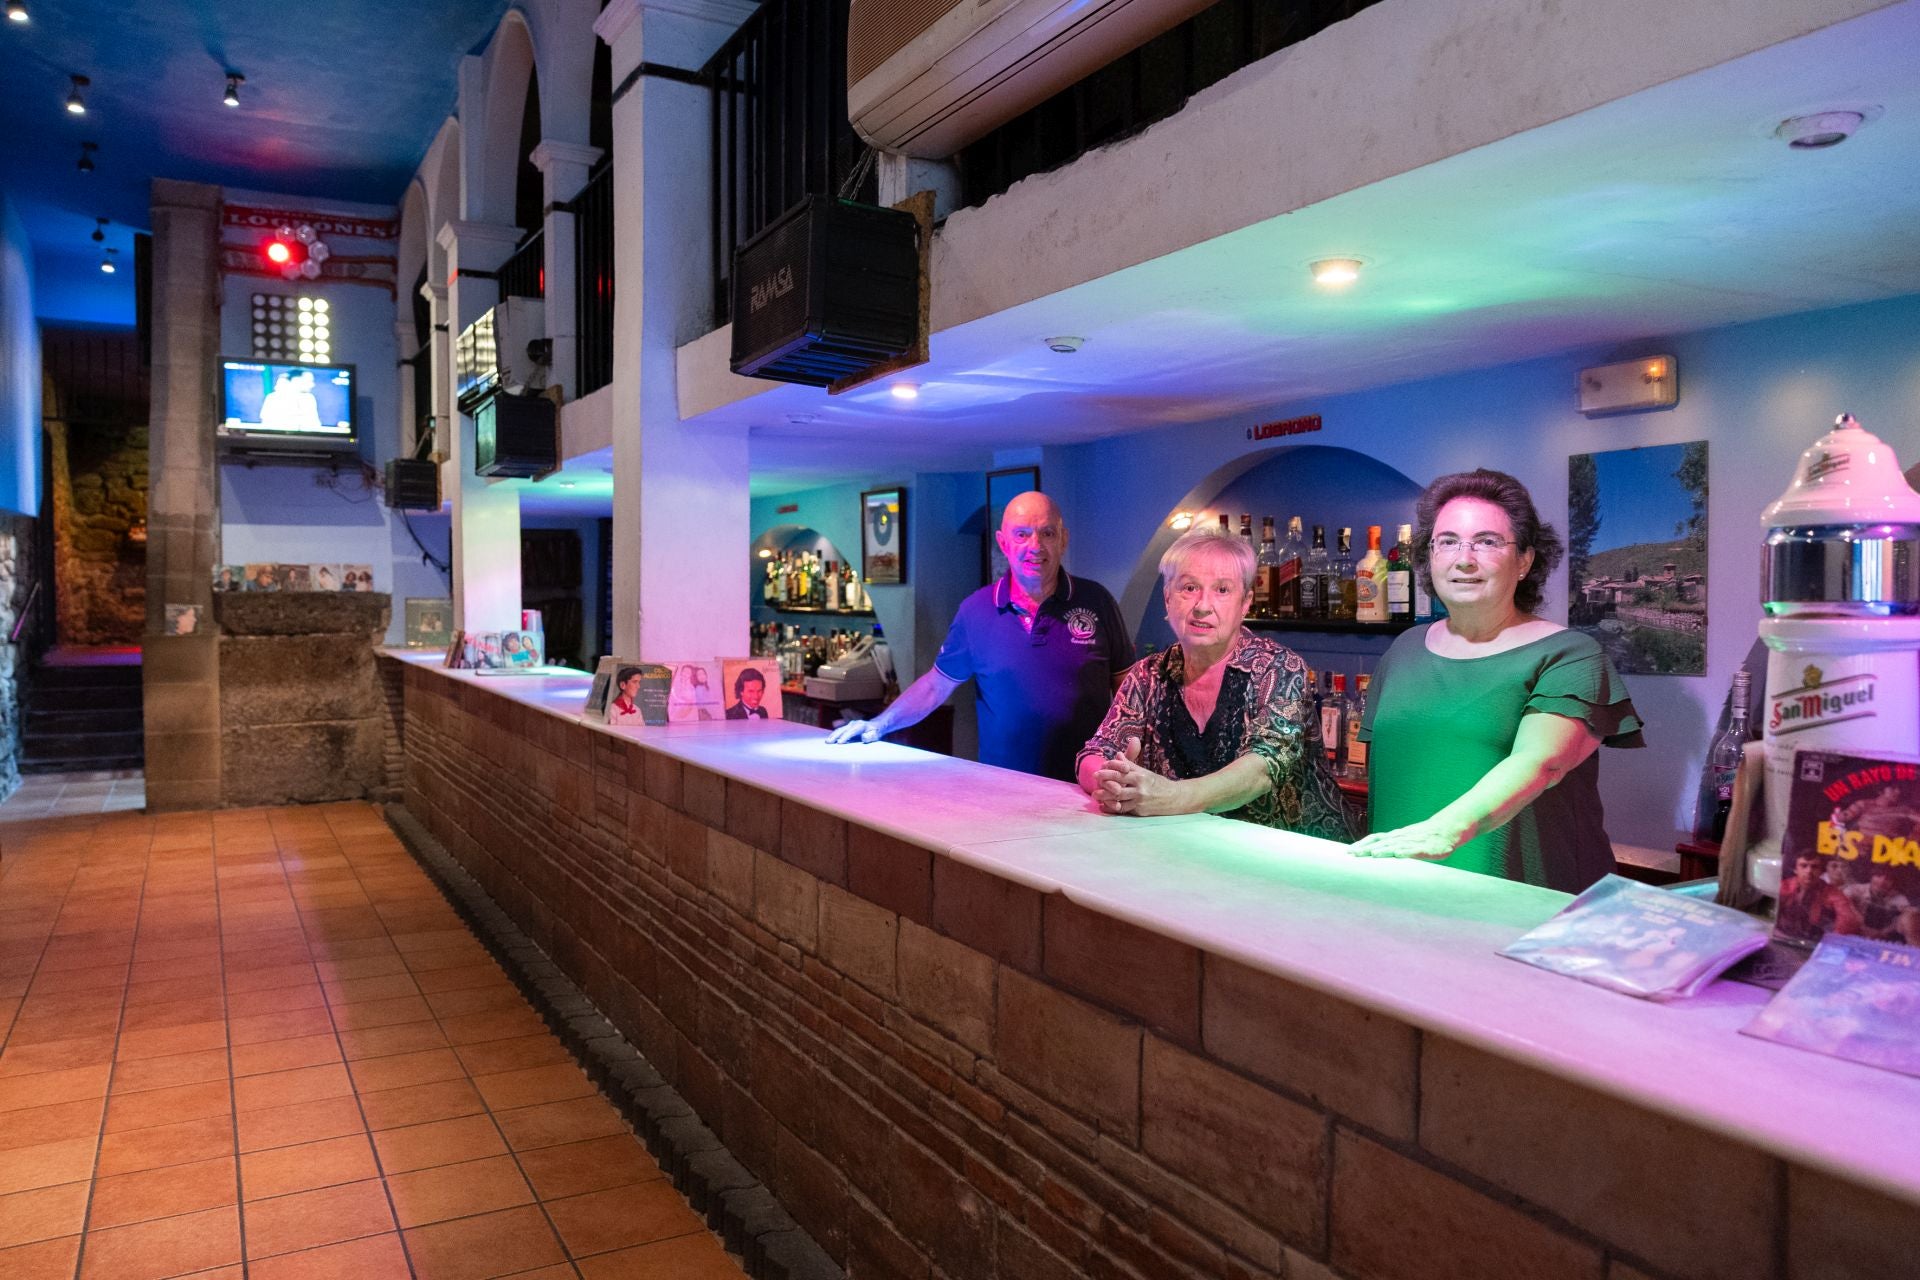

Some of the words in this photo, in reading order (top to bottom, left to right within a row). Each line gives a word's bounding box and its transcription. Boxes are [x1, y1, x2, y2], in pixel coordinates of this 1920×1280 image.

[750, 264, 794, 313] RAMSA
[1823, 779, 1850, 803] UN
[1846, 764, 1893, 790] RAYO
